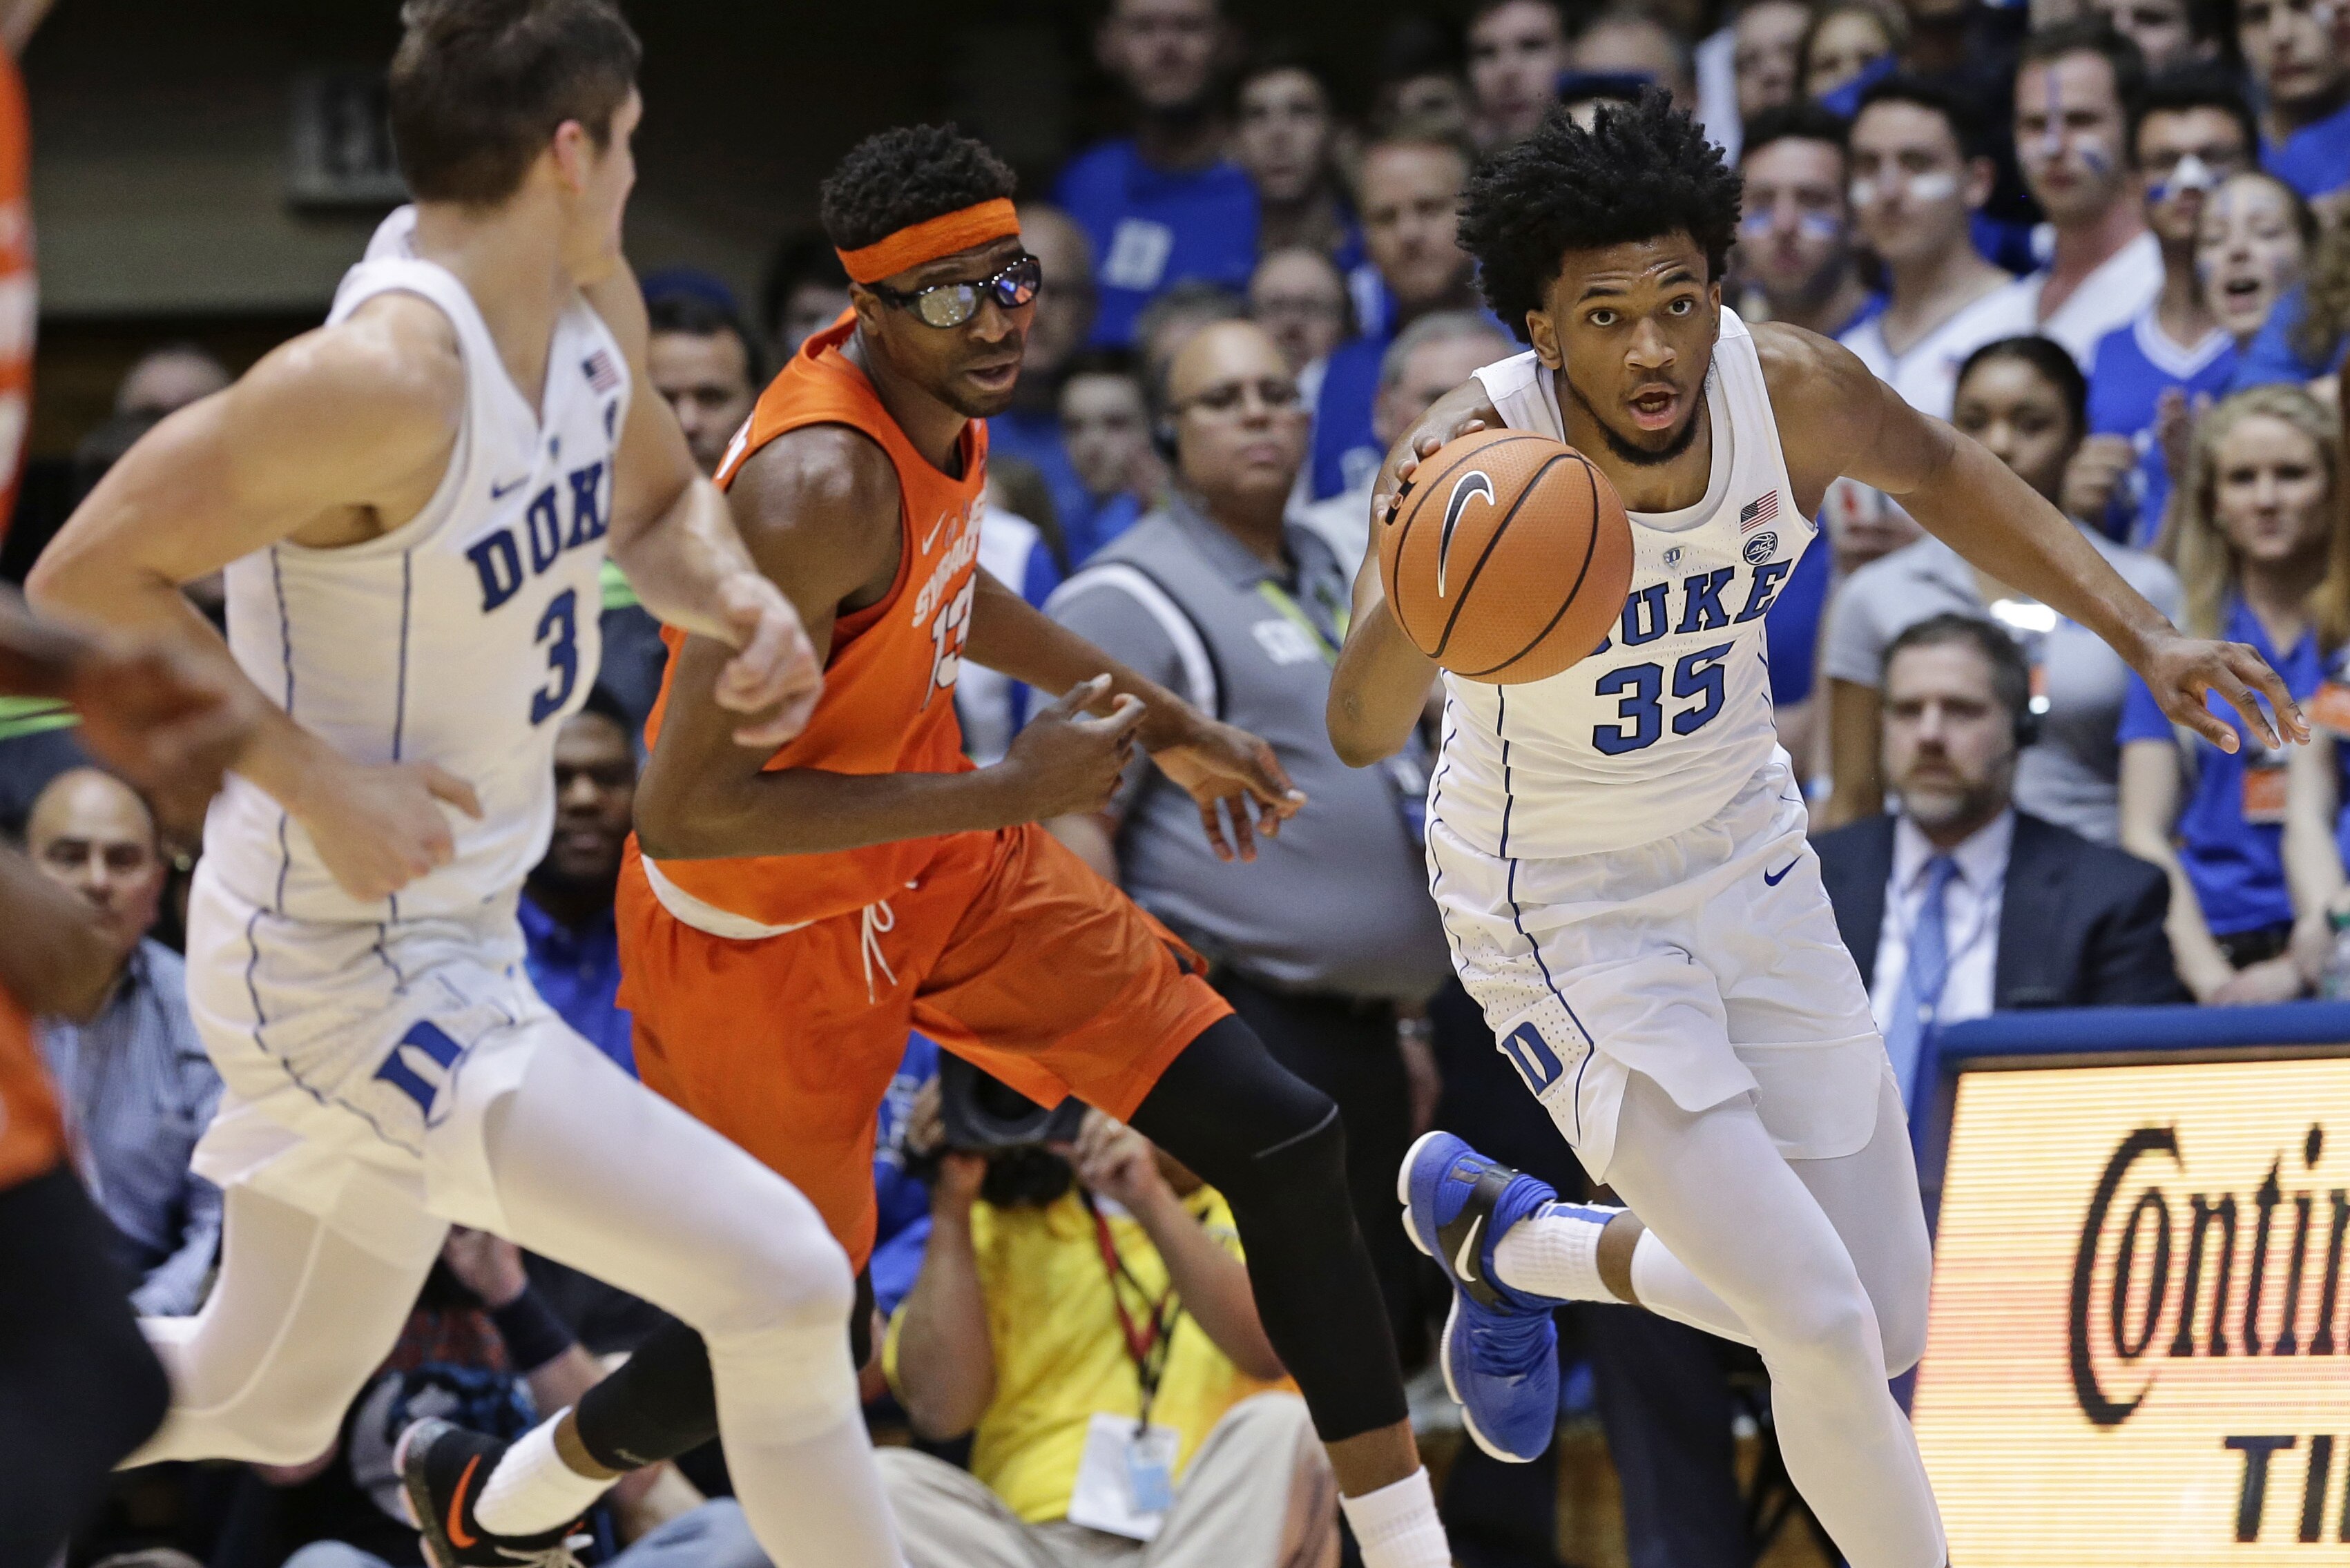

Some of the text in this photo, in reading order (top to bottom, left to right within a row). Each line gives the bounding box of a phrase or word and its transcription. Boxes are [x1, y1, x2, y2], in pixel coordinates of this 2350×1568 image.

[466, 460, 610, 613] DUK
[529, 587, 579, 727] 3
[921, 570, 977, 713] 13
[1586, 559, 1793, 658] UKE
[1592, 639, 1737, 756] 35
[1501, 1021, 1563, 1096] D
[2224, 1435, 2350, 1543] TI
